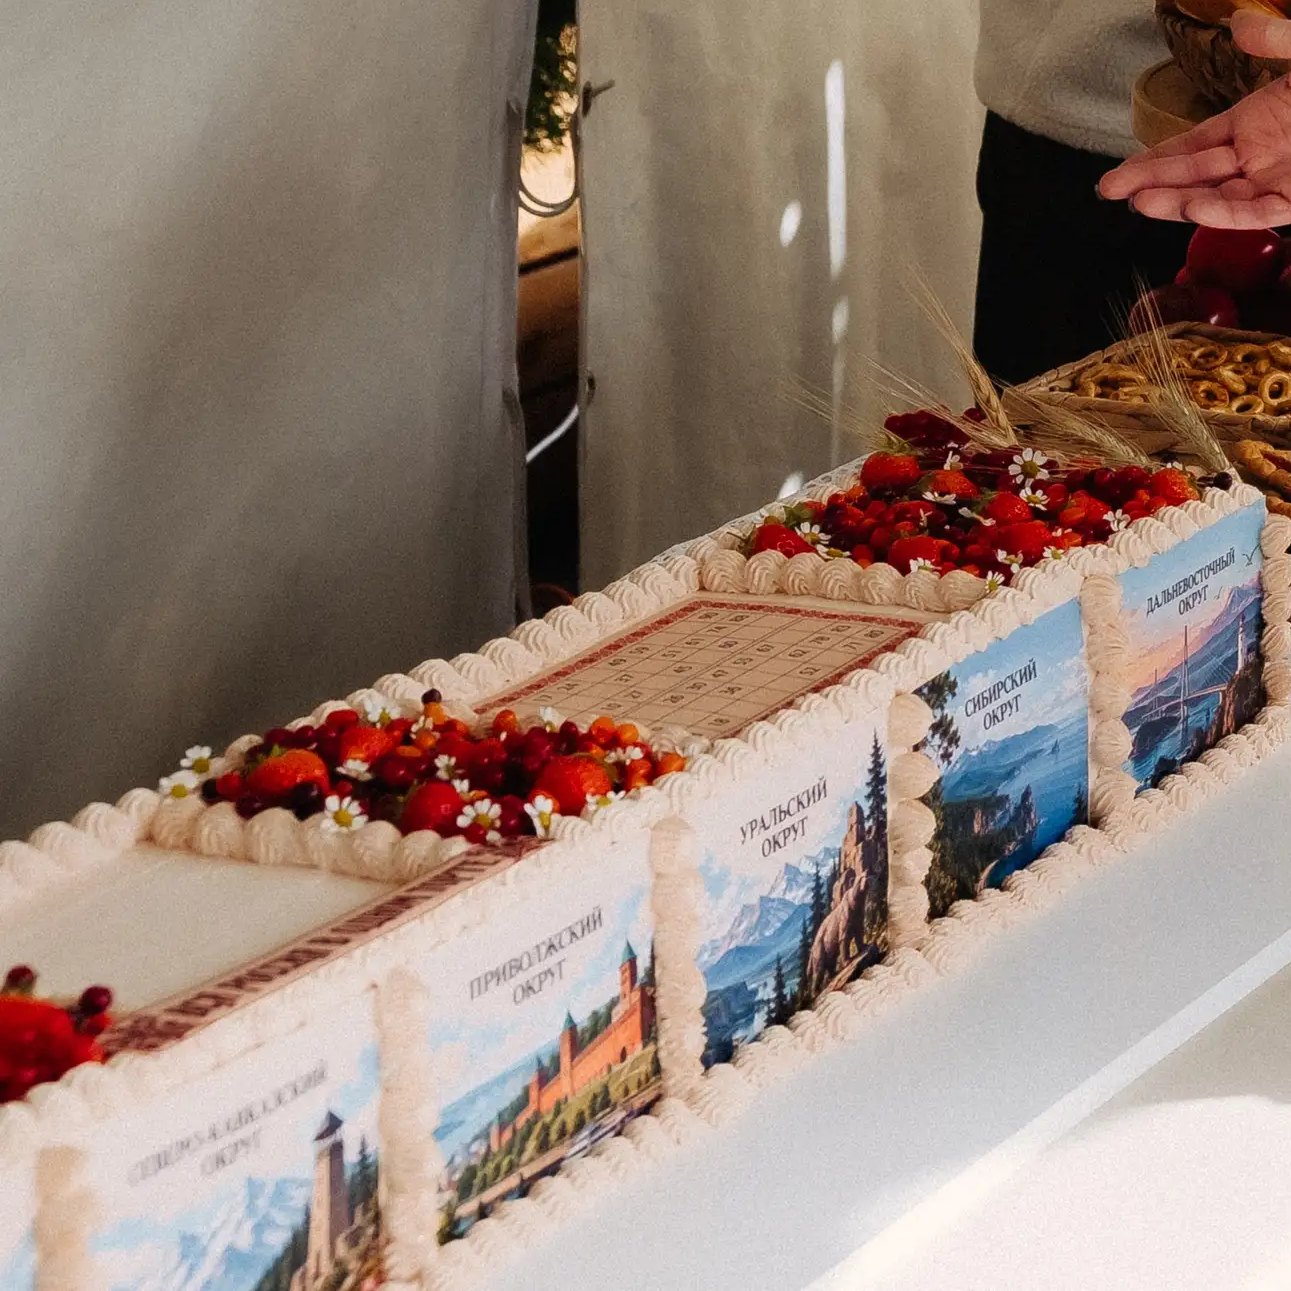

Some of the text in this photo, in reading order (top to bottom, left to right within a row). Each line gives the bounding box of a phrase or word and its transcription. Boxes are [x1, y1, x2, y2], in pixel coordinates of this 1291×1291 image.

[1146, 546, 1235, 618] ДАЛЬНЕВОСТОЧНЫЙ
[1178, 584, 1209, 615] ОКРУГ
[788, 648, 810, 658] 62
[799, 666, 821, 675] 52
[841, 641, 865, 649] 71
[614, 673, 634, 683] 37
[711, 669, 729, 678] 47
[965, 657, 1037, 717] СИБИРСКИЙ
[624, 690, 643, 699] 27
[983, 694, 1021, 730] ОКРУГ
[740, 775, 827, 846] УРАЛЬСКИЙ
[761, 815, 808, 857] ОКРУГ
[470, 906, 603, 1000] ПРИВОЛЖСКИЙ
[512, 958, 567, 1005] ОКРУГ
